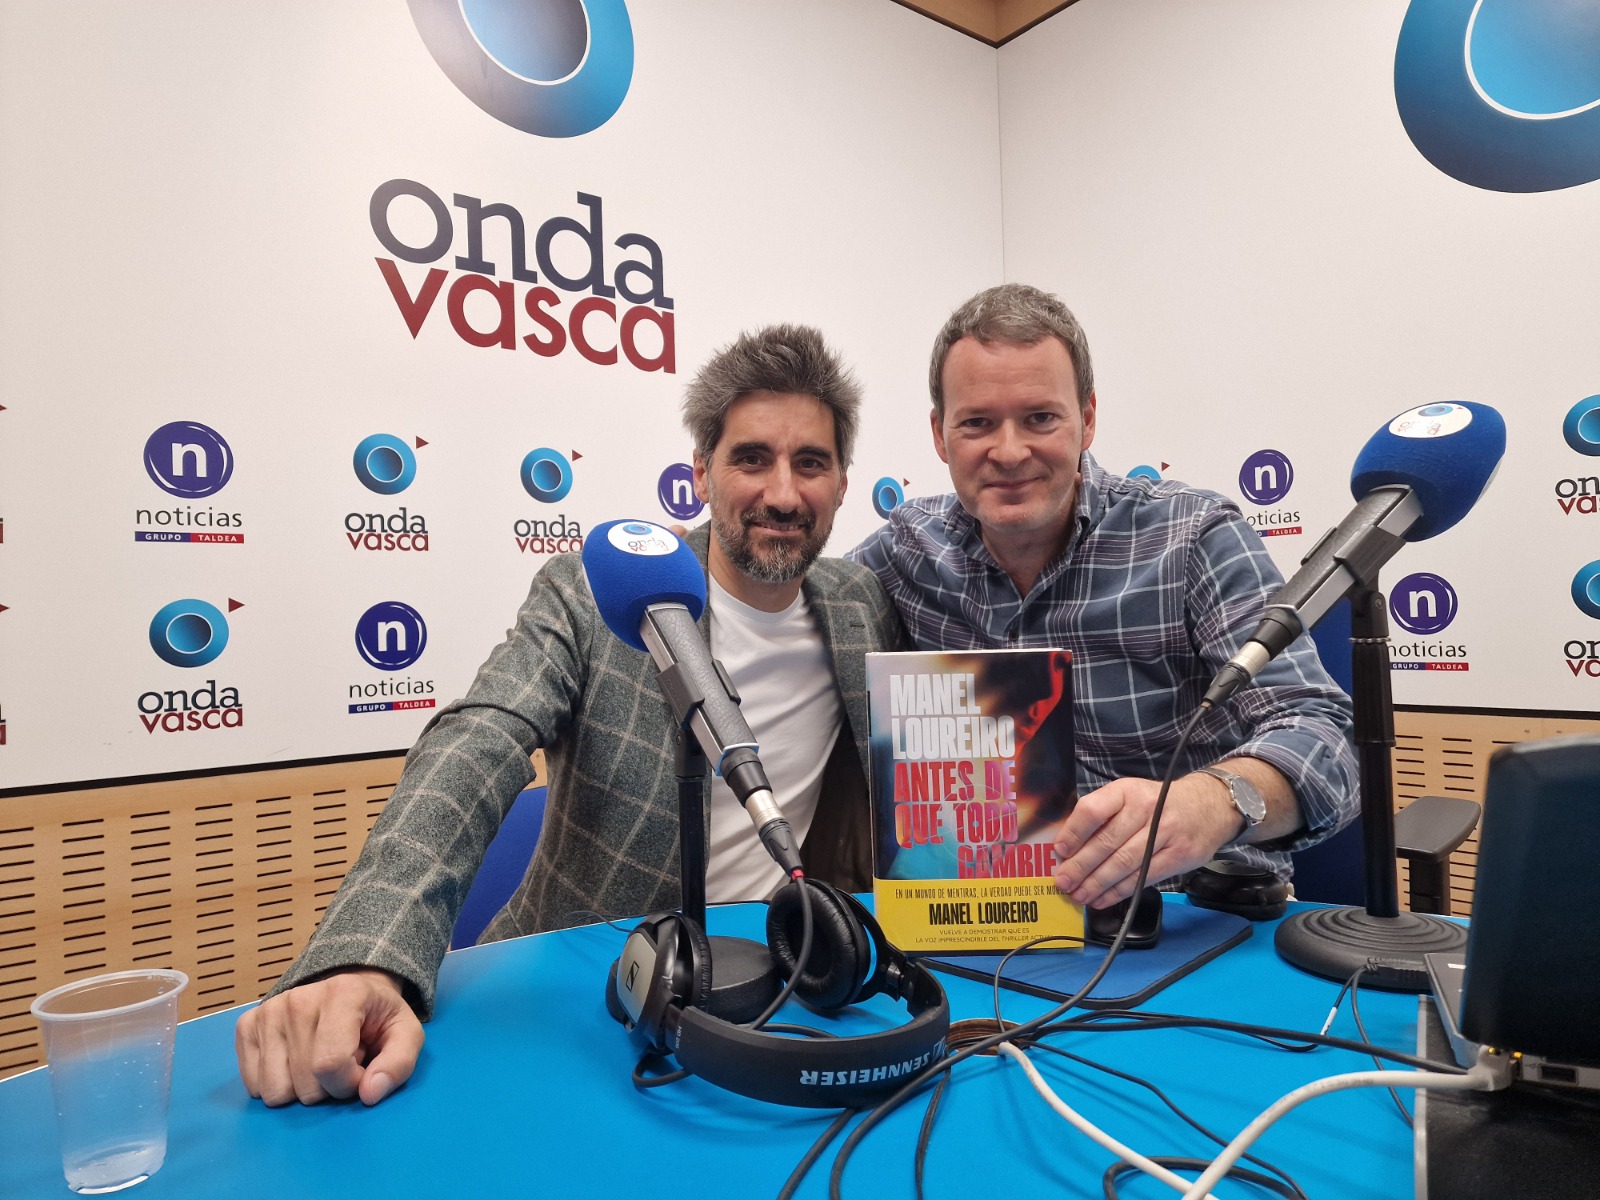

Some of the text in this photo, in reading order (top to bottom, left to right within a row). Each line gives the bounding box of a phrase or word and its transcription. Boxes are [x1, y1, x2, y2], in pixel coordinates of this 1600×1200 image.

[369, 178, 675, 310] onda
[374, 257, 676, 374] vasca
[171, 442, 207, 477] n
[1254, 464, 1277, 491] n
[672, 479, 693, 505] n
[136, 506, 242, 527] noticias
[344, 507, 428, 534] onda
[513, 514, 582, 538] onda
[1246, 509, 1301, 526] oticias
[145, 533, 237, 542] GRUPO TALDEA
[346, 532, 429, 552] vasca
[1272, 528, 1298, 536] TALDEA
[1408, 589, 1437, 618] n
[377, 620, 407, 652] n
[1388, 640, 1467, 658] noticias
[137, 680, 243, 714] onda
[349, 677, 434, 698] noticias
[890, 673, 981, 716] MANEL
[356, 700, 431, 712] GRUPO TALDEA
[139, 708, 243, 734] vasca
[892, 715, 1016, 760] LOUREIRO
[894, 760, 1017, 802] ANTES DE
[895, 802, 1019, 849] QUE TODO
[895, 889, 903, 899] EN
[905, 889, 913, 899] UN
[915, 888, 936, 899] MUNDO
[938, 888, 945, 898] DE
[947, 887, 979, 899] MENTIRAS,
[981, 887, 988, 897] LA
[990, 886, 1012, 897] VERDAD
[1014, 886, 1032, 897] PUEDE
[1034, 885, 1045, 896] SER
[929, 901, 1039, 926] MANEL LOUREIRO
[939, 936, 987, 944] IMPRESCINDIBLE
[799, 1052, 930, 1086] SENNHEISER
